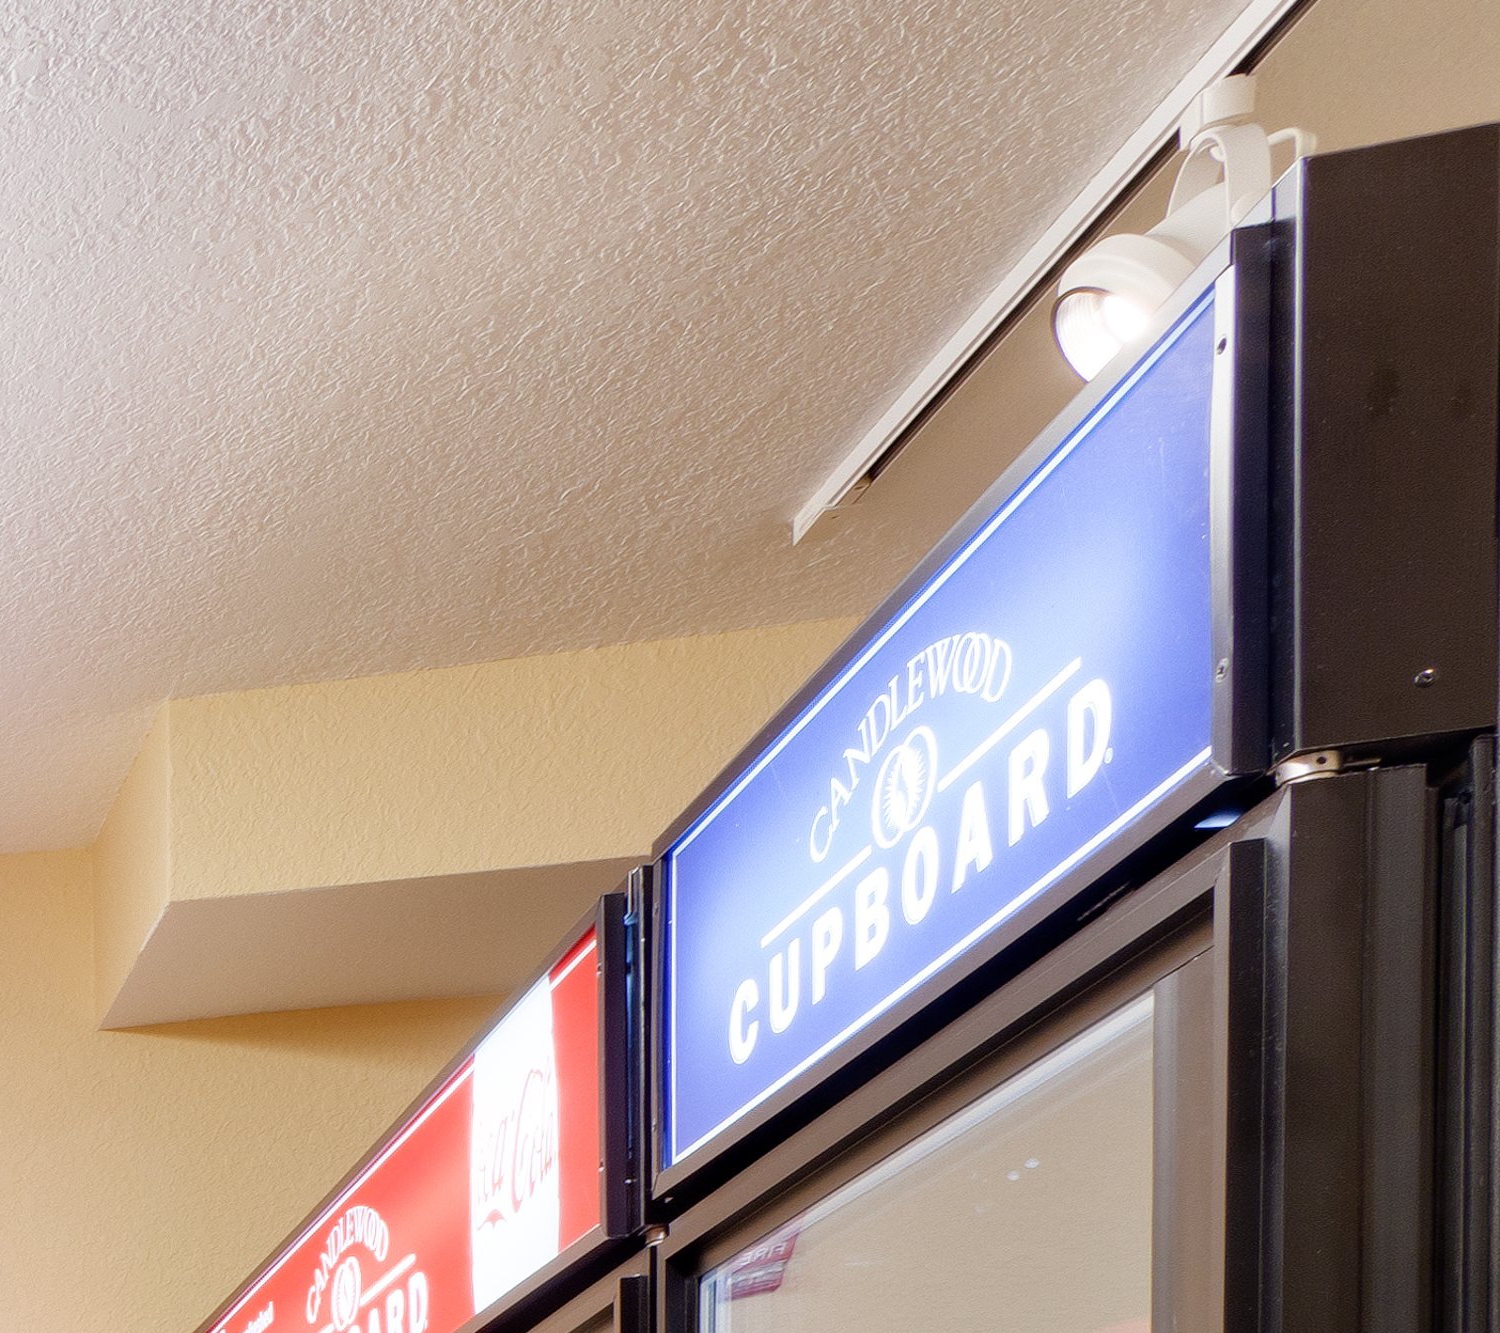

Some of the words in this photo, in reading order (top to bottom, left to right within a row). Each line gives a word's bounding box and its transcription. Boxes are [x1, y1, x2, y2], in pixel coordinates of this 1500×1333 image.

[811, 631, 1012, 862] CANDLEWOOD
[726, 679, 1113, 1064] CUPBOARD
[307, 1206, 389, 1323] CANDLEWOOD
